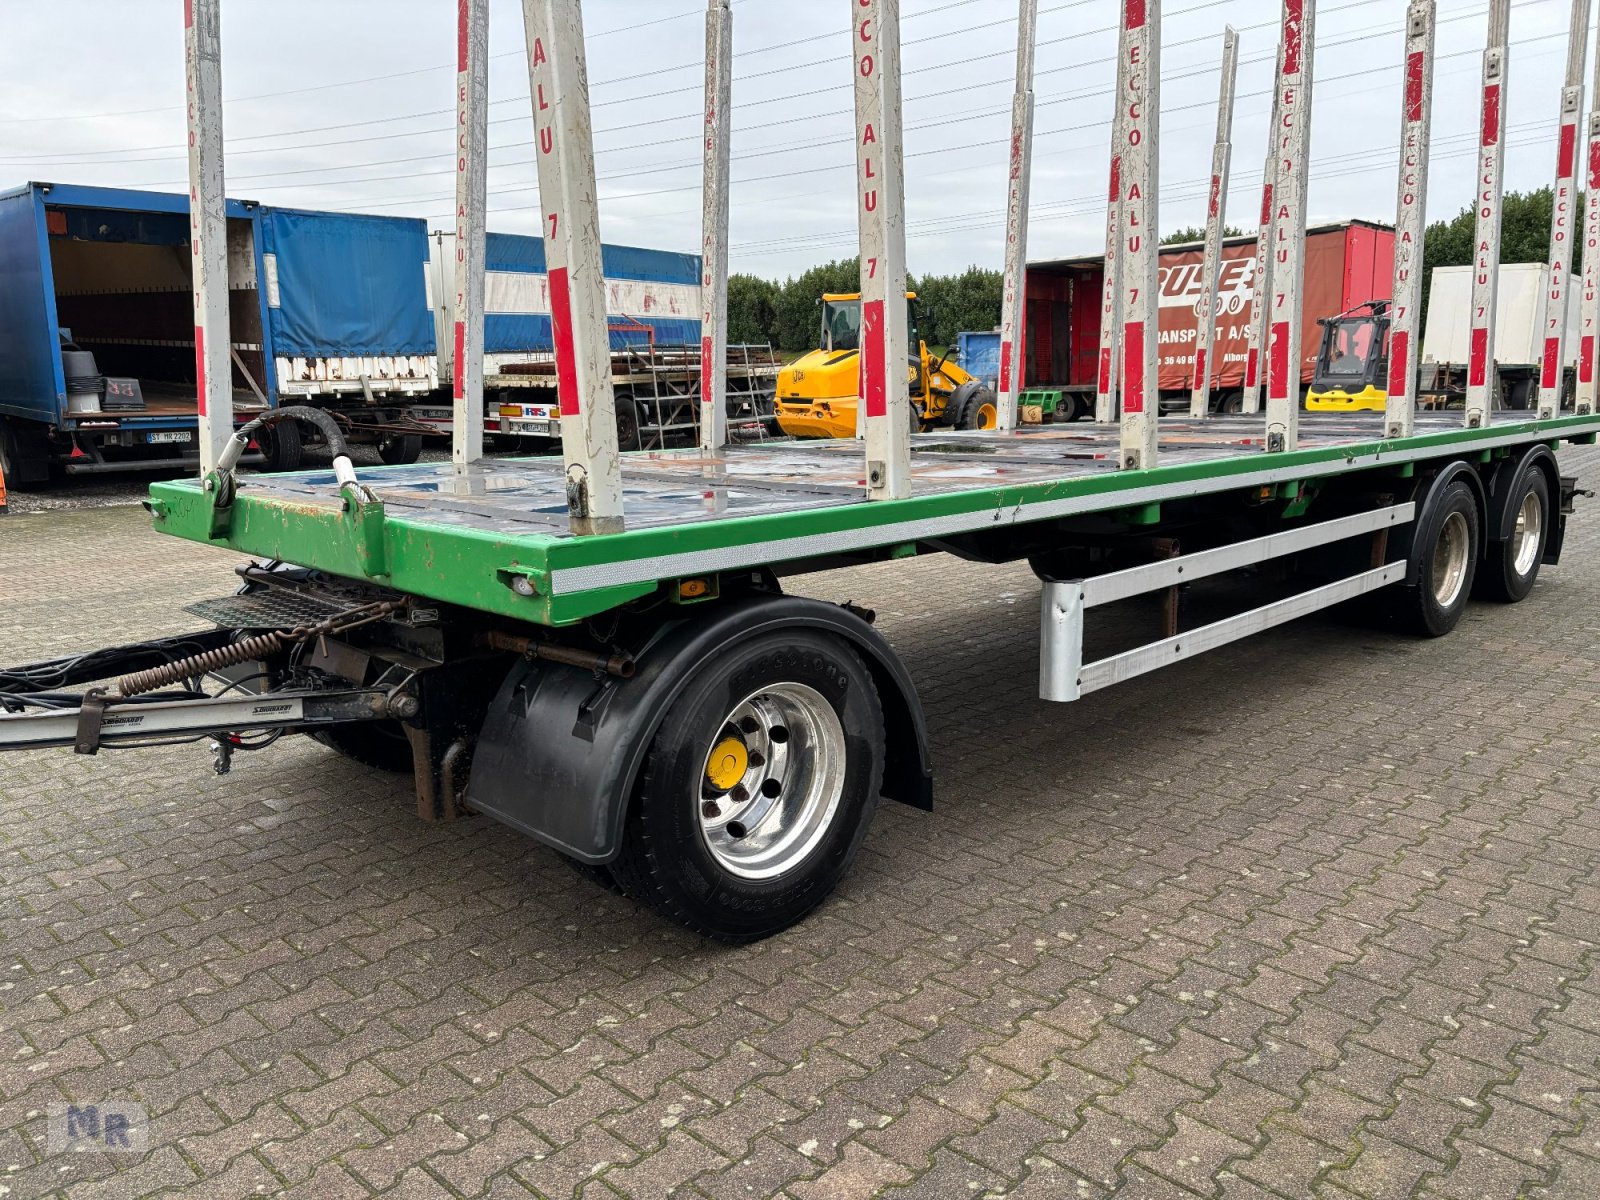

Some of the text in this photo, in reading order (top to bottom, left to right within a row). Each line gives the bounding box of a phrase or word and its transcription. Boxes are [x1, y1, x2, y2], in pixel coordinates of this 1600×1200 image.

[533, 37, 558, 240] ALU 7
[862, 123, 877, 212] ALU
[1128, 46, 1141, 305] ECCO ALU 7
[1403, 135, 1416, 206] ECCO
[191, 185, 199, 256] ALU
[457, 87, 466, 305] ECCO ALU 7
[1008, 188, 1017, 244] ECCO
[1277, 204, 1290, 263] ALU
[1477, 156, 1493, 318] ECCO ALU 7
[1588, 198, 1598, 248] ECCO
[867, 257, 877, 279] 7
[1257, 232, 1267, 275] ECCO
[1550, 187, 1567, 329] ECCO ALU 7
[705, 312, 710, 324] 7
[1105, 278, 1113, 313] ALU
[1254, 290, 1262, 320] ALU
[1276, 294, 1285, 308] 7
[1397, 307, 1406, 319] 7
[1005, 322, 1011, 333] 7
[1585, 318, 1592, 328] 7
[525, 407, 547, 417] RTS
